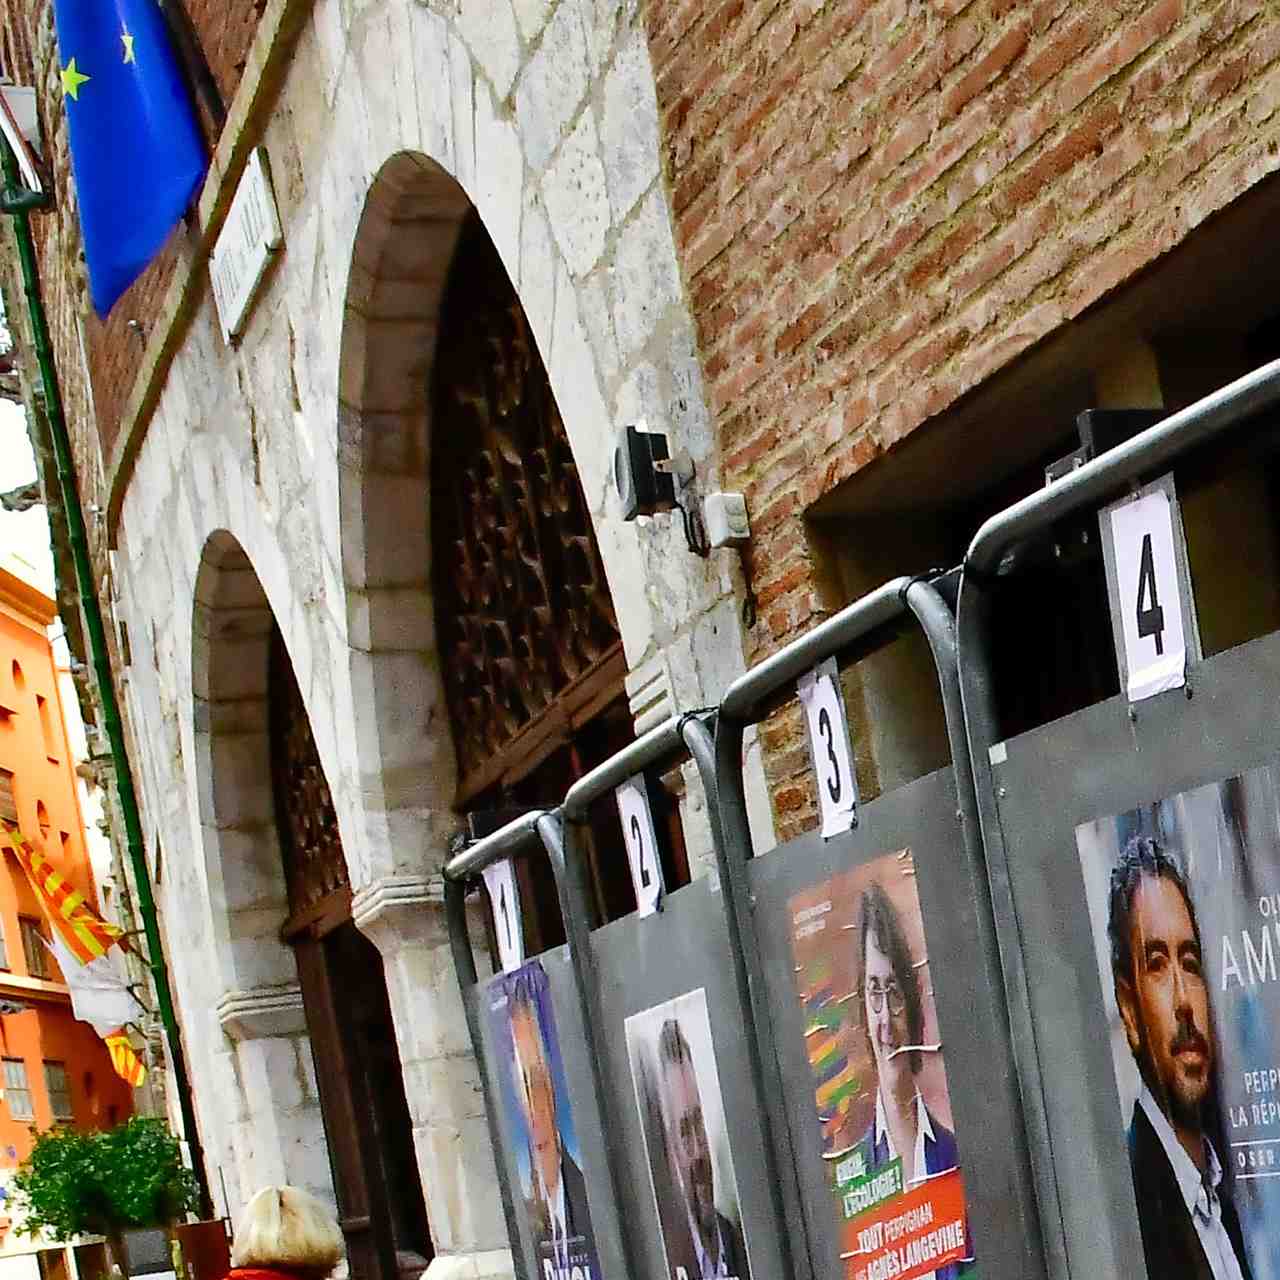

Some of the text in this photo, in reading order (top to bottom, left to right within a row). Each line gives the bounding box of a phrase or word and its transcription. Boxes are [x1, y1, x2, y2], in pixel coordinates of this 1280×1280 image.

[1136, 533, 1166, 656] 4
[819, 707, 841, 803] 3
[631, 814, 650, 888] 2
[500, 883, 513, 950] 1
[1229, 1106, 1249, 1129] LA
[900, 1220, 965, 1271] LANGEVINE
